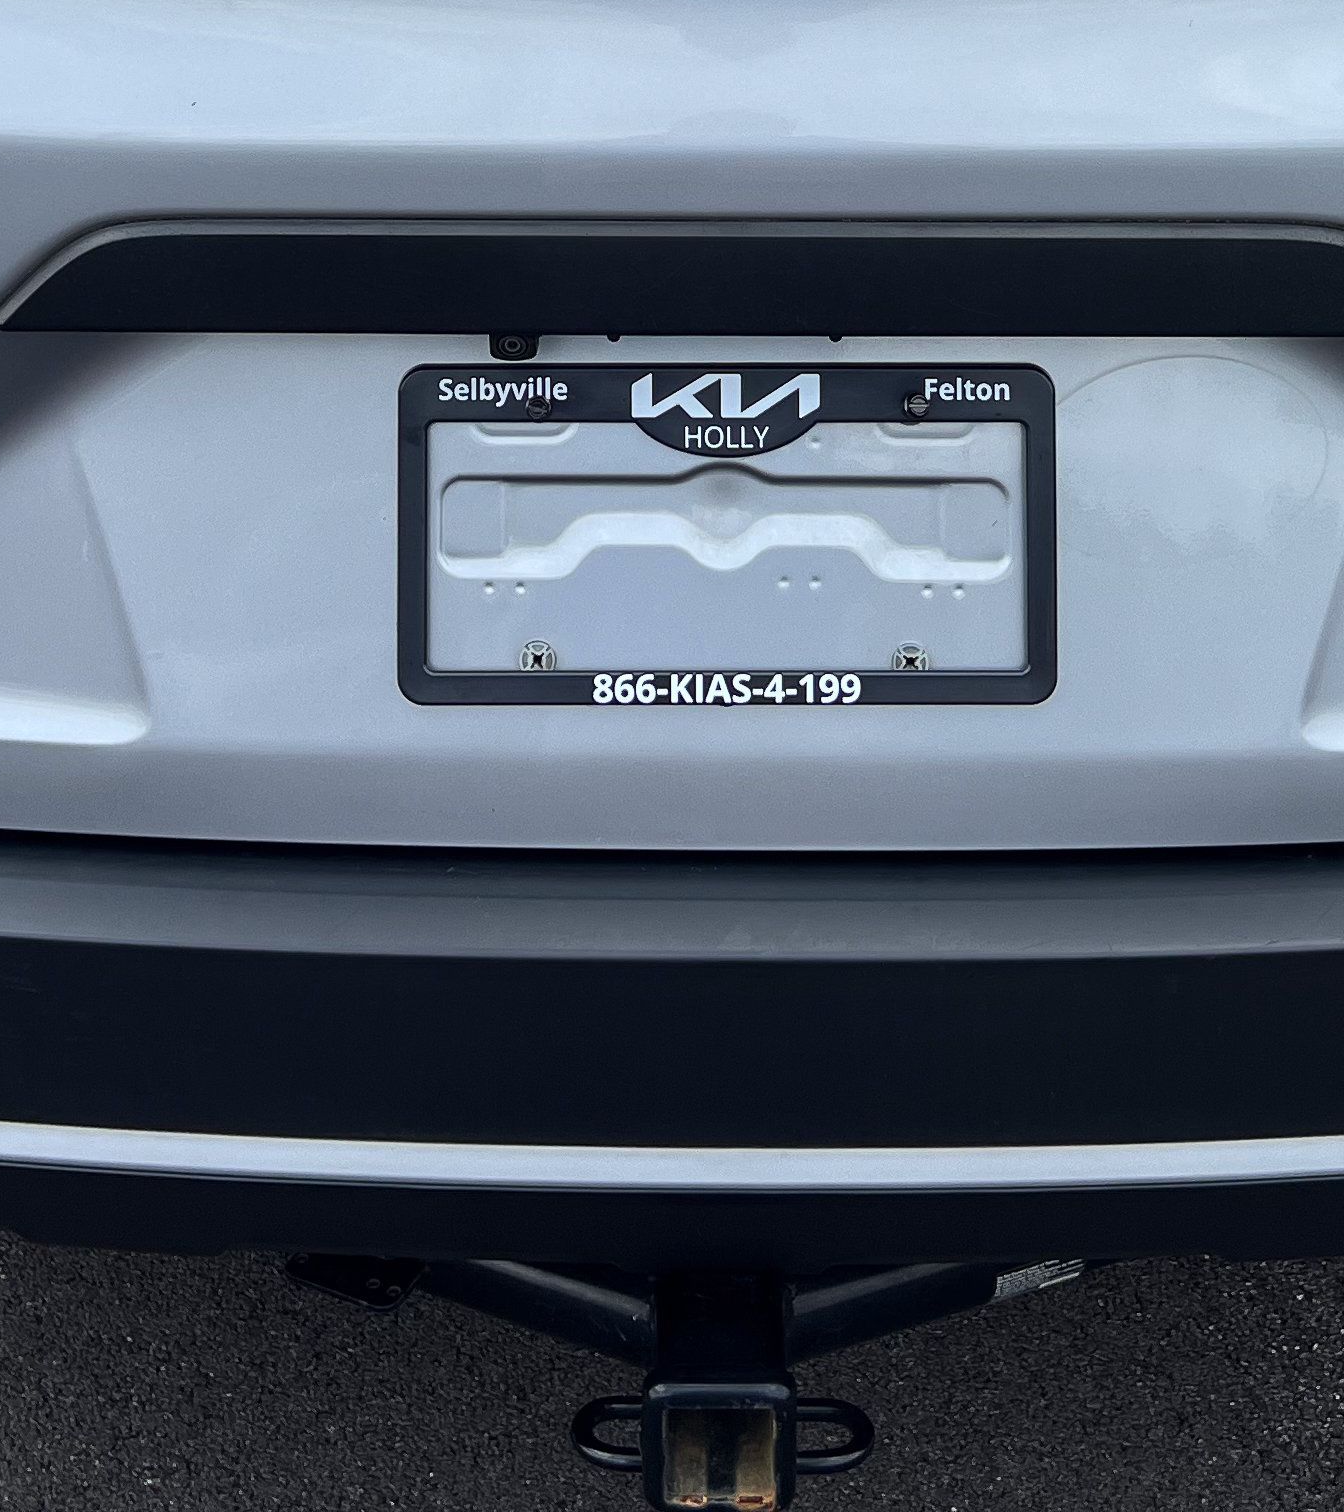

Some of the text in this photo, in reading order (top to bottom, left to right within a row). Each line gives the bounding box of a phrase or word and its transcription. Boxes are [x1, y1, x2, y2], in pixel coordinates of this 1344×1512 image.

[438, 377, 568, 406] Selbyville
[631, 373, 821, 419] KIA
[923, 377, 1011, 402] Felton
[683, 425, 770, 450] HOLLY
[592, 673, 862, 705] 866-KIAS-4-199
